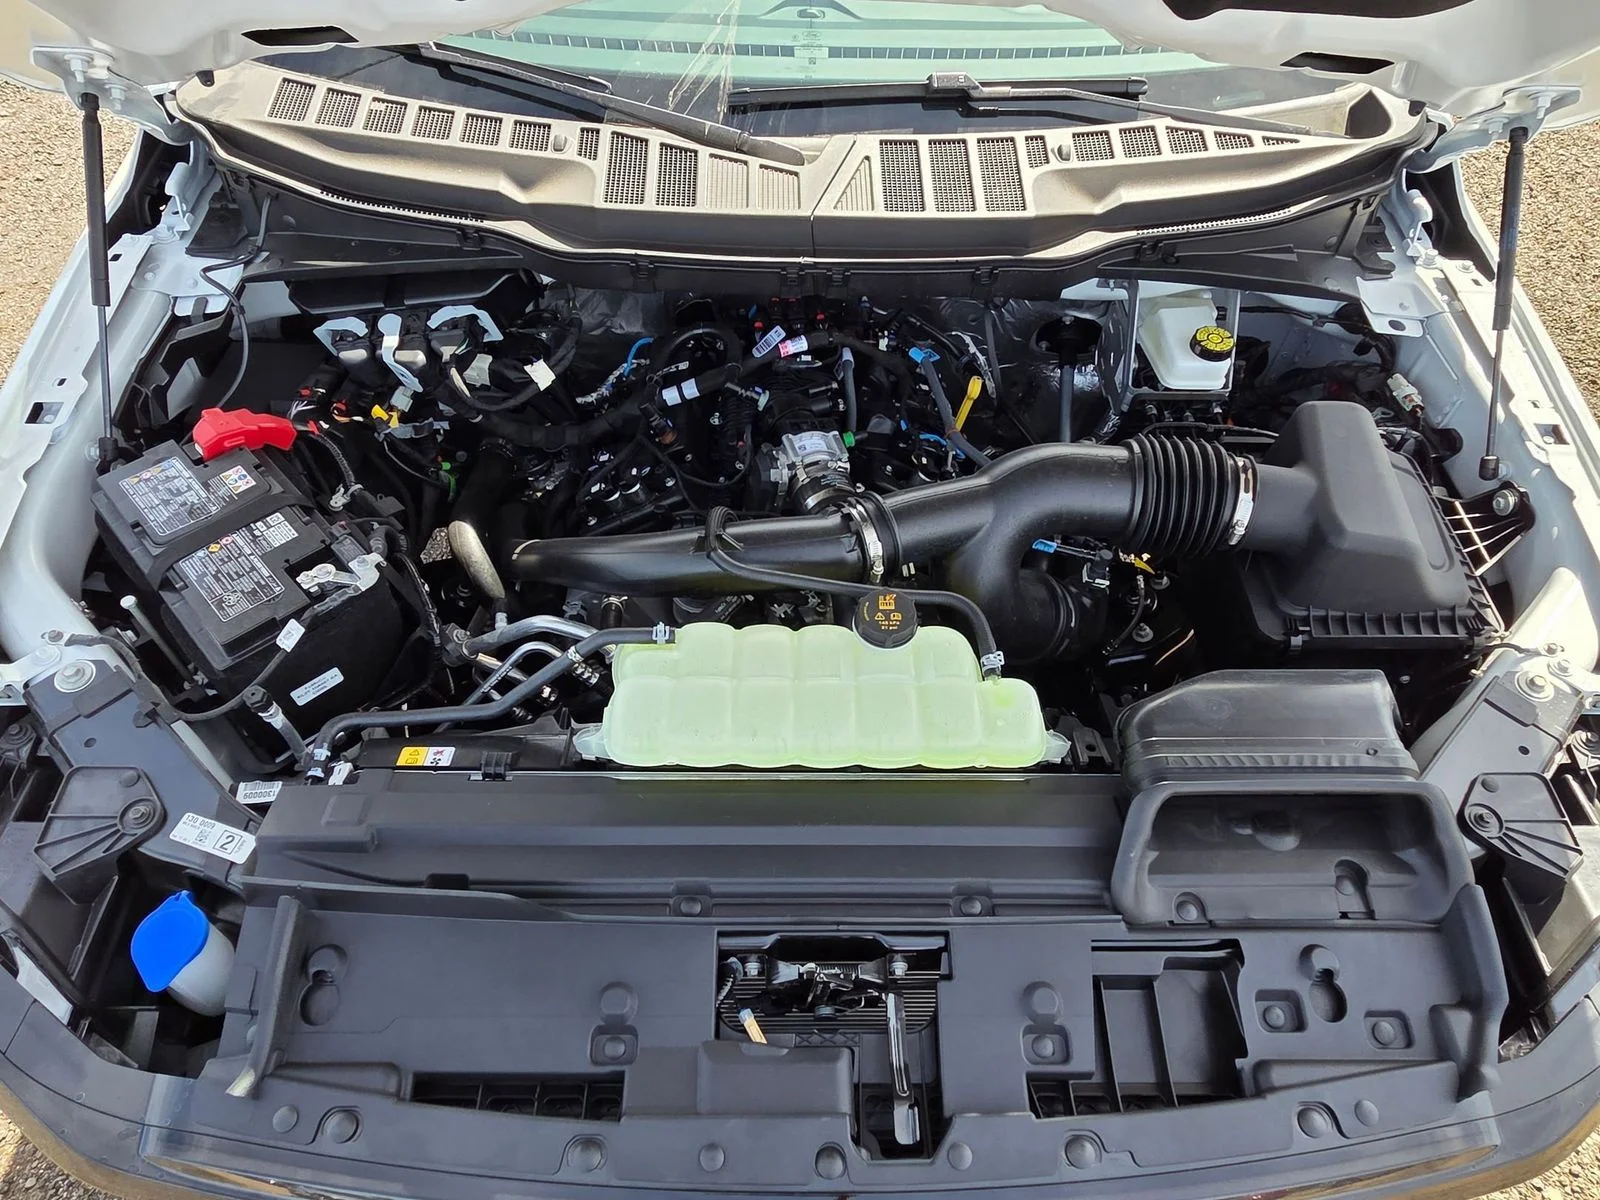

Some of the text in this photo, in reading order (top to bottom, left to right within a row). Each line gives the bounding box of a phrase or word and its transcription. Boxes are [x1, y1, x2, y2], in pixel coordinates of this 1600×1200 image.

[243, 790, 276, 799] 1300009
[185, 815, 199, 823] 130
[219, 834, 235, 851] 2
